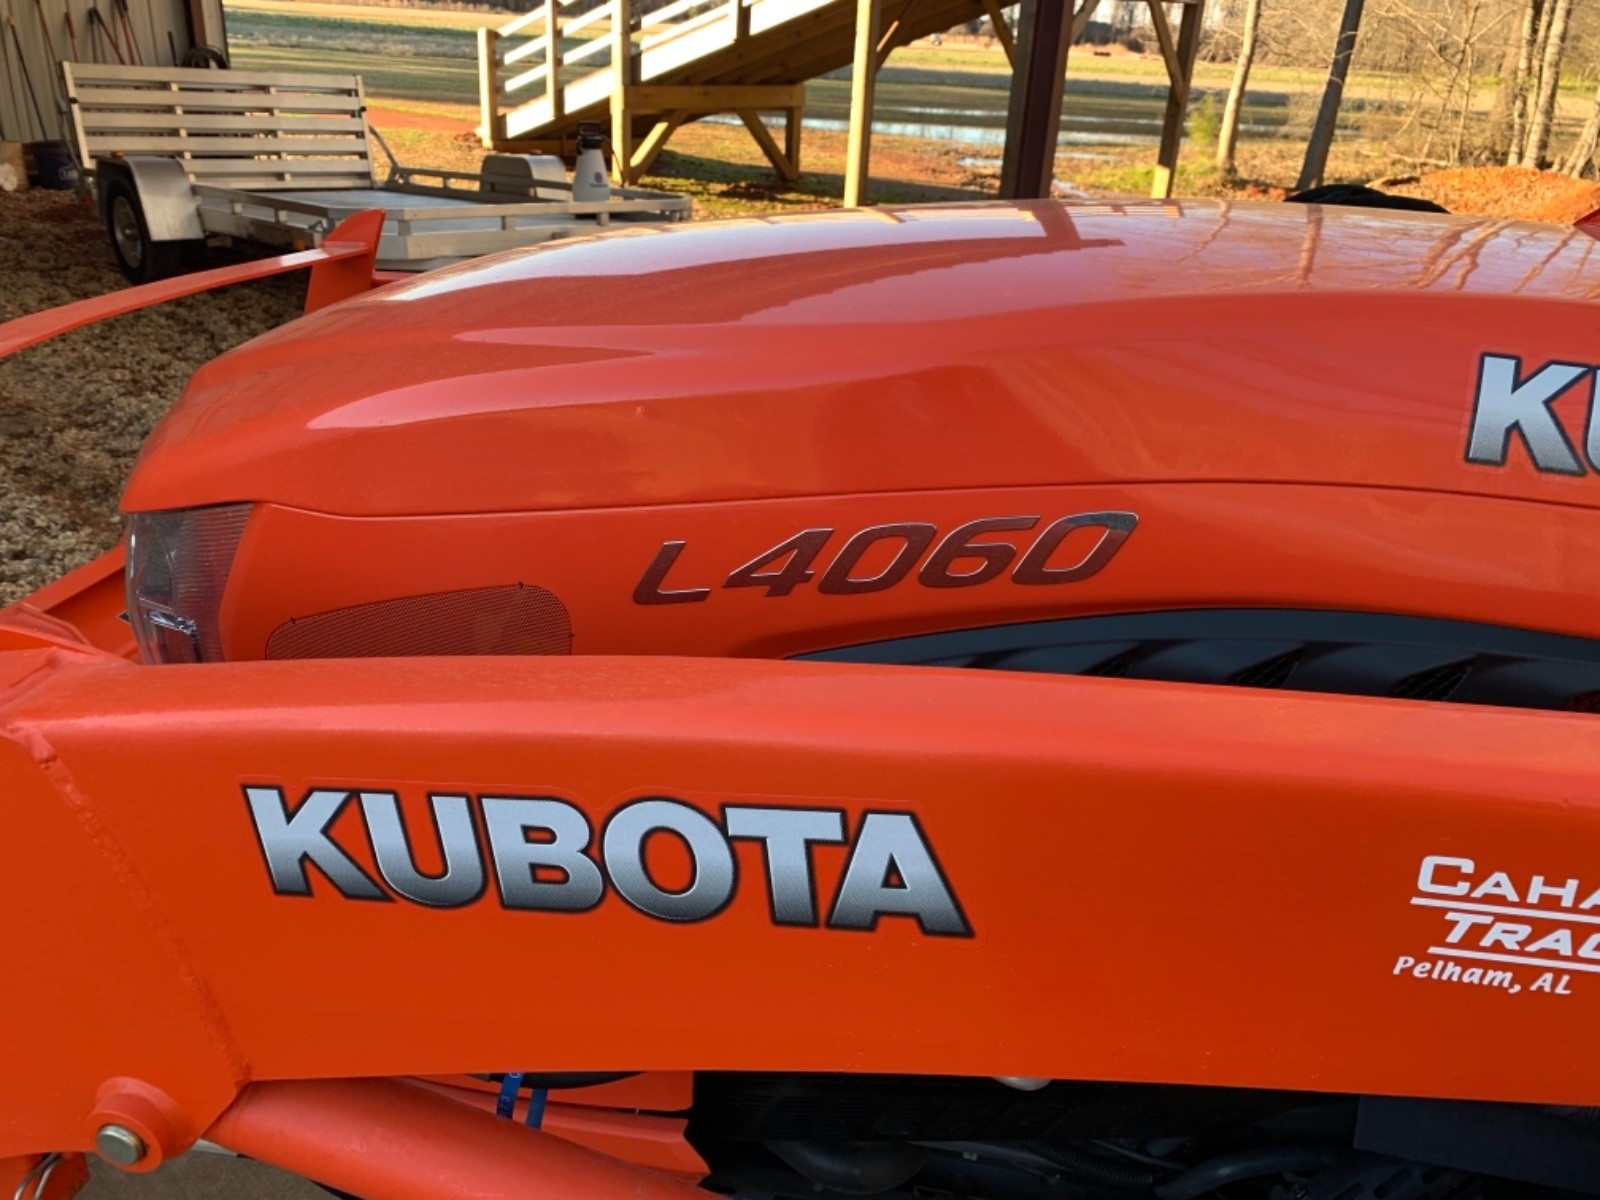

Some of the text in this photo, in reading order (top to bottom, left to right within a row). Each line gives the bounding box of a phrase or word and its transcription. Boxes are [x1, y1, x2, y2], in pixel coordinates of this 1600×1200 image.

[632, 511, 1139, 605] L4060
[241, 784, 976, 938] KUBOTA
[1393, 956, 1572, 995] Pelham, AL
